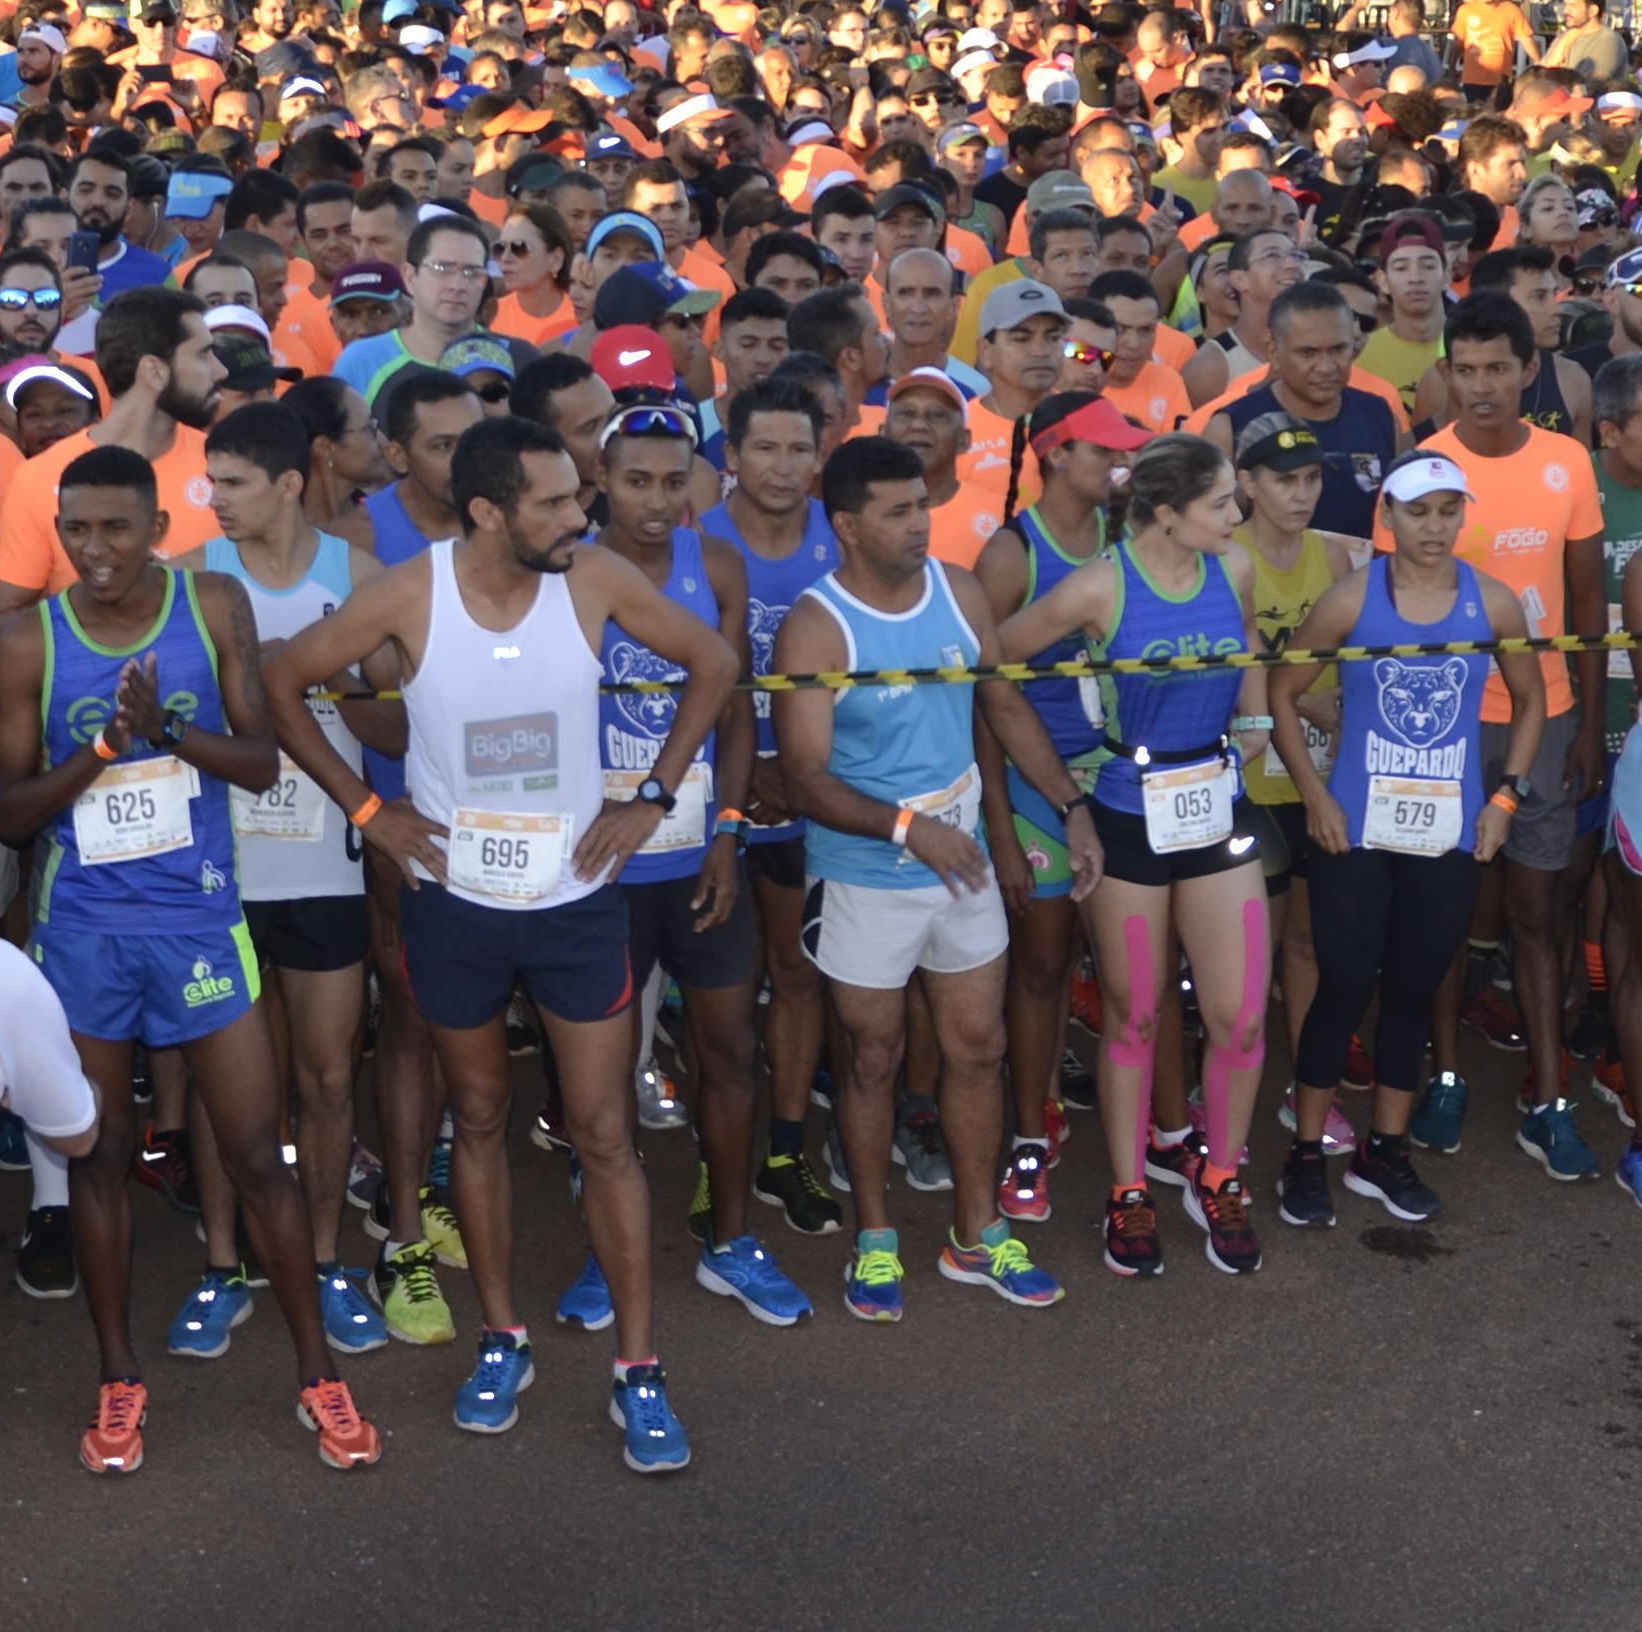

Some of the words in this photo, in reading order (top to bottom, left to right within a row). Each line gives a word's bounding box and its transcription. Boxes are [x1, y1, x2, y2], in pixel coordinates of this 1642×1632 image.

[471, 728, 552, 763] BigBig
[1365, 729, 1467, 780] GUEPARDO
[106, 788, 157, 826] 625
[1174, 786, 1213, 820] 053
[1394, 800, 1437, 827] 579
[481, 837, 530, 870] 695
